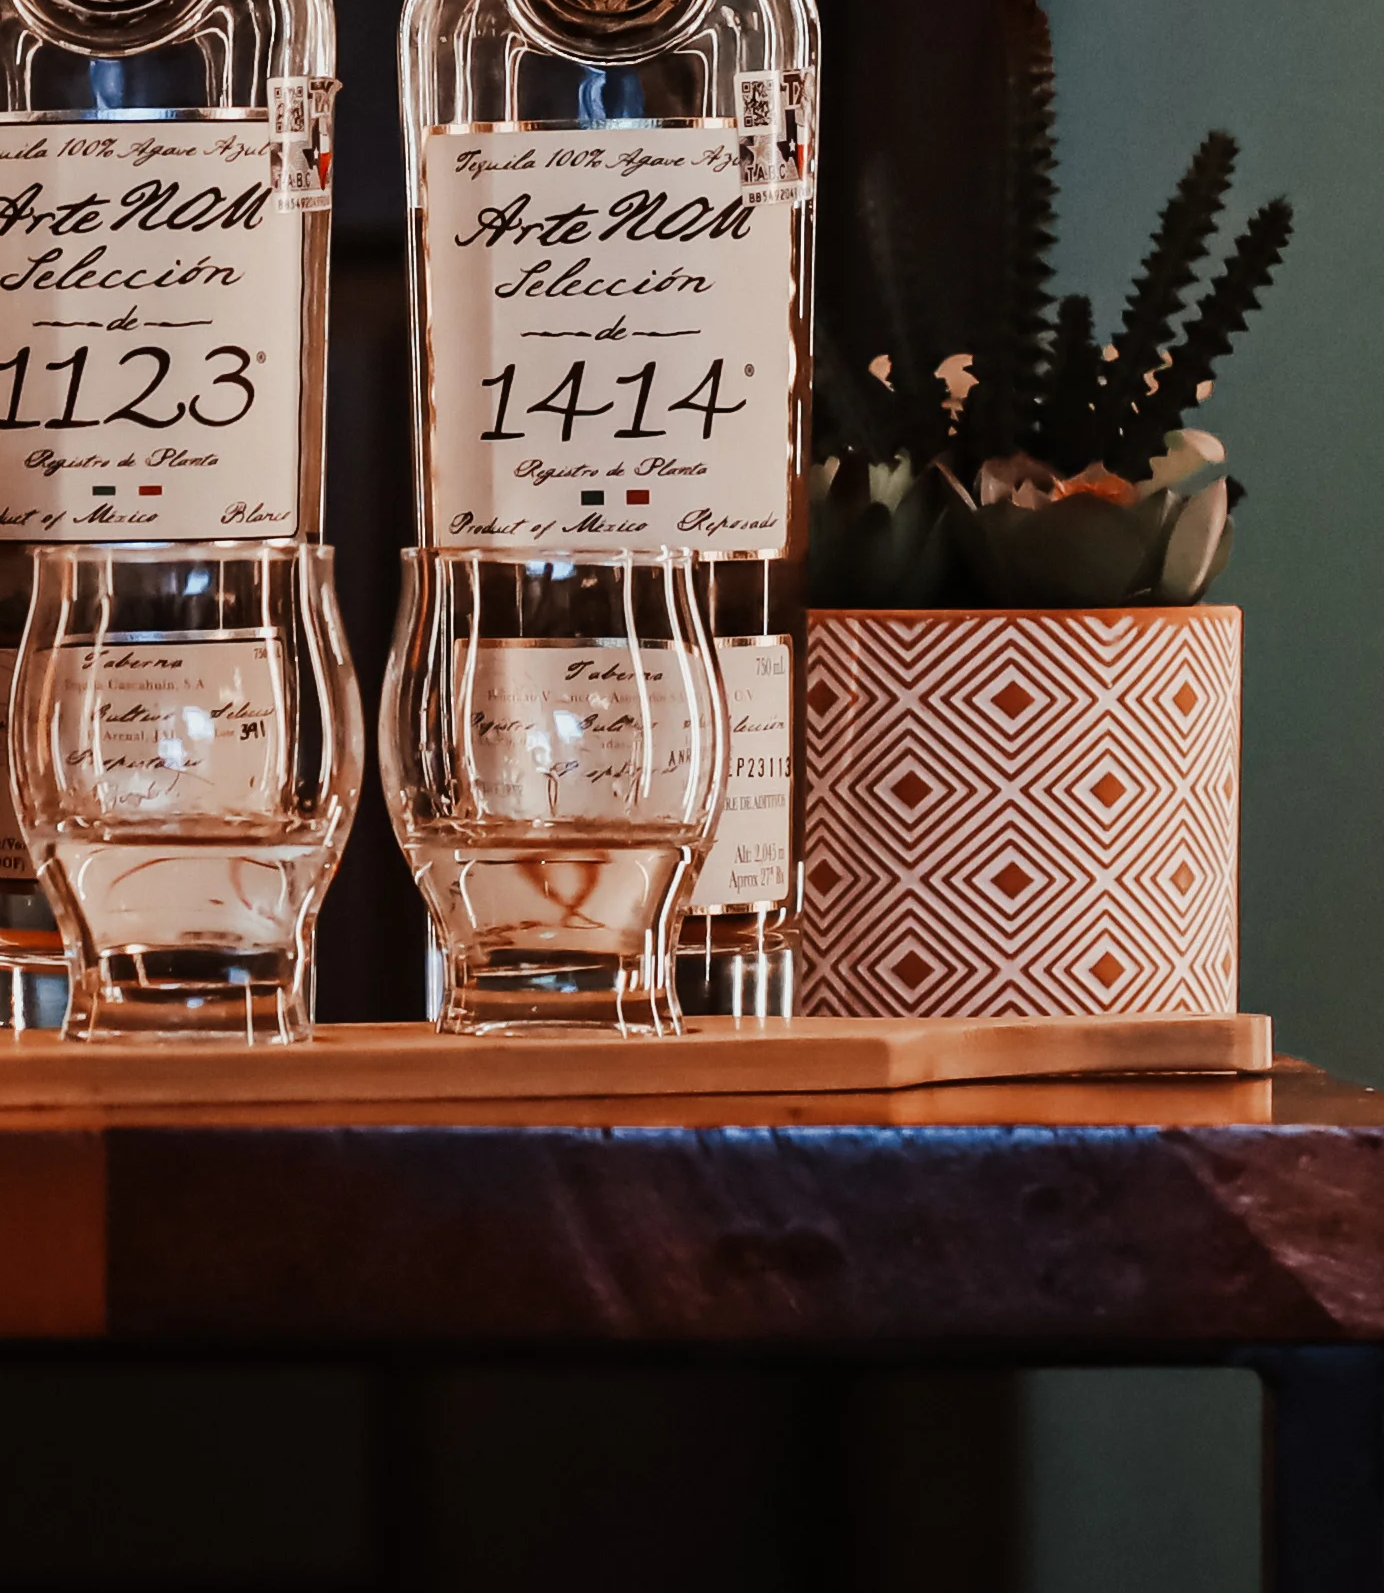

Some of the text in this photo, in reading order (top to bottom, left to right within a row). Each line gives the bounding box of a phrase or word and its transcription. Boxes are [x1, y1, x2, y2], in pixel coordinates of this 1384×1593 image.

[57, 137, 117, 159] 100%
[117, 135, 198, 167] Agave
[455, 149, 537, 180] Tequila
[544, 148, 604, 169] 100%
[604, 147, 685, 178] Agave
[110, 179, 273, 232] NOM
[454, 193, 600, 249] Arte
[0, 244, 245, 292] Selección
[494, 257, 715, 299] Selección
[106, 305, 139, 332] de
[595, 315, 628, 342] de
[480, 358, 747, 442] 1414
[24, 447, 220, 478] Registro de Planta
[514, 457, 709, 487] Registro de Planta
[40, 507, 63, 531] of
[449, 511, 524, 536] Product
[533, 518, 554, 542] of
[676, 508, 780, 536] Reposado
